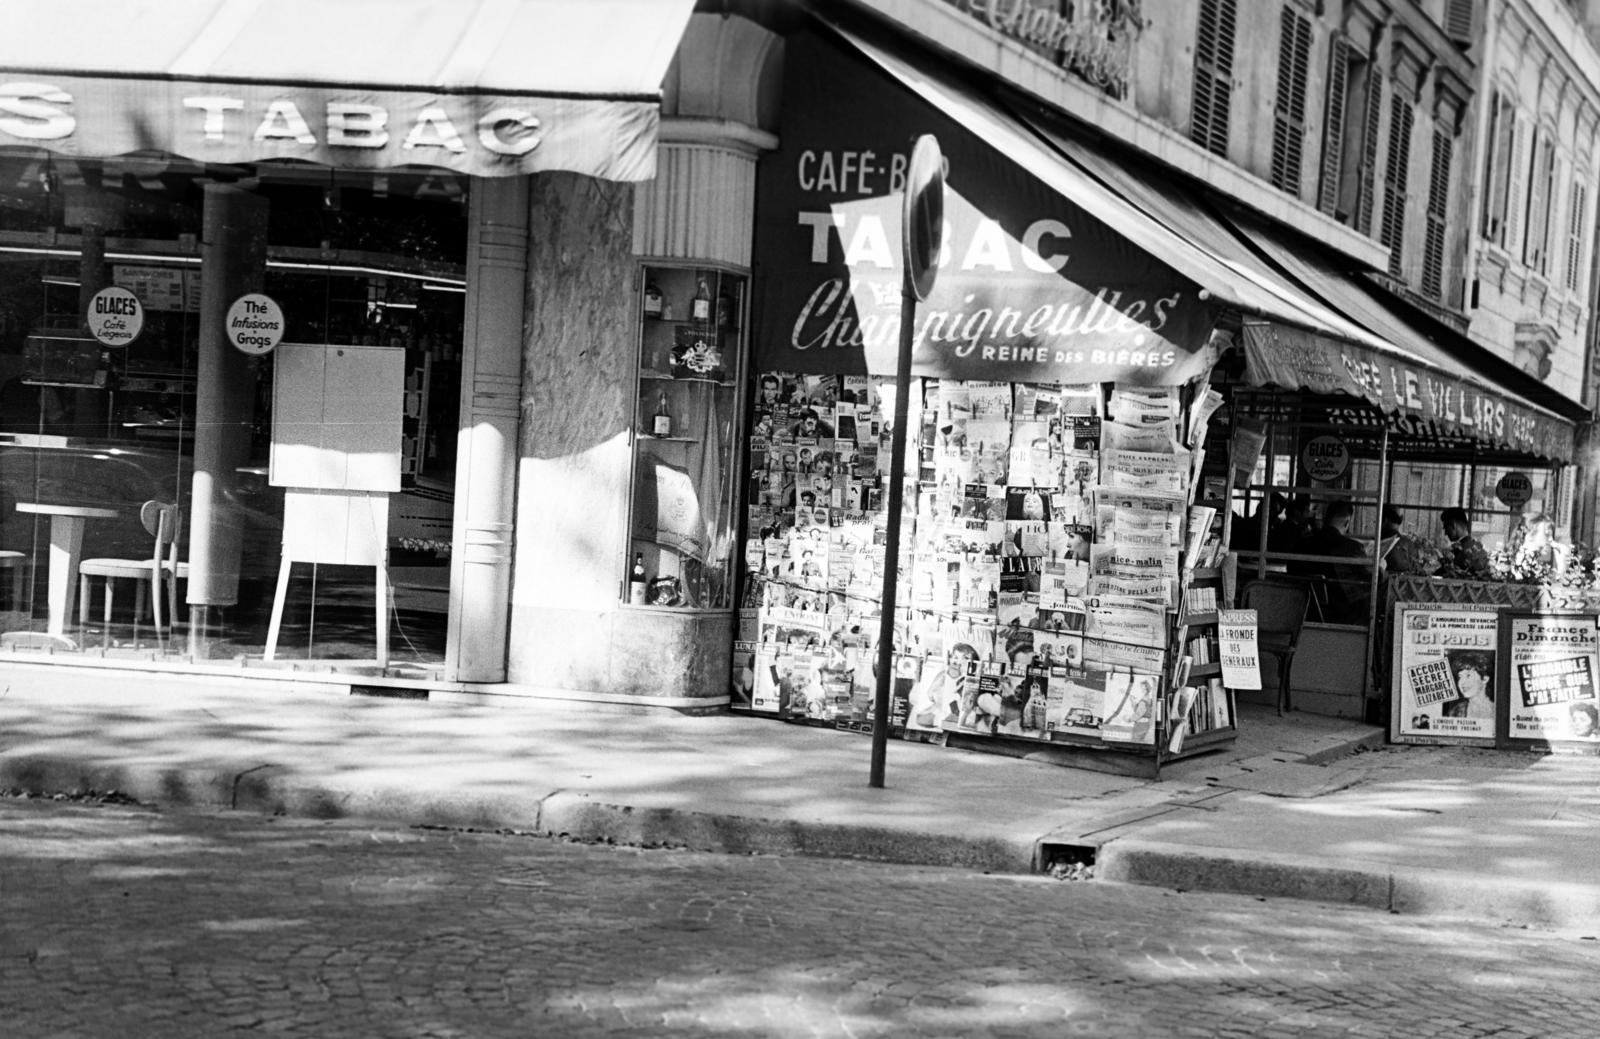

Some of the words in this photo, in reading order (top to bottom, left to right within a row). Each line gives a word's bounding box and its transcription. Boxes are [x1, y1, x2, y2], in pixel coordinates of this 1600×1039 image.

[184, 97, 542, 156] TABAC
[96, 296, 137, 316] GLACES
[244, 301, 268, 314] Thé
[103, 320, 127, 329] Café
[231, 316, 280, 330] Infusions
[236, 332, 272, 349] Grogs
[982, 344, 1049, 363] REINE
[1055, 350, 1084, 364] DES
[1390, 367, 1424, 411] LE
[1426, 377, 1506, 437] VILLARS
[1309, 442, 1344, 457] GLACES
[1000, 557, 1042, 573] FLAIR
[1226, 629, 1255, 640] FRONDE
[1528, 624, 1589, 634] France
[1416, 632, 1437, 645] Ici
[1441, 633, 1489, 647] Paris
[1516, 632, 1597, 644] Dimanche
[1229, 643, 1241, 653] DES
[1410, 661, 1447, 678] ACCORD
[1412, 672, 1449, 687] SECRET
[1524, 675, 1562, 692] CHOSE
[1566, 671, 1590, 687] QUE
[1414, 679, 1452, 696] MARGARET
[1417, 689, 1455, 706] ELIZABETH
